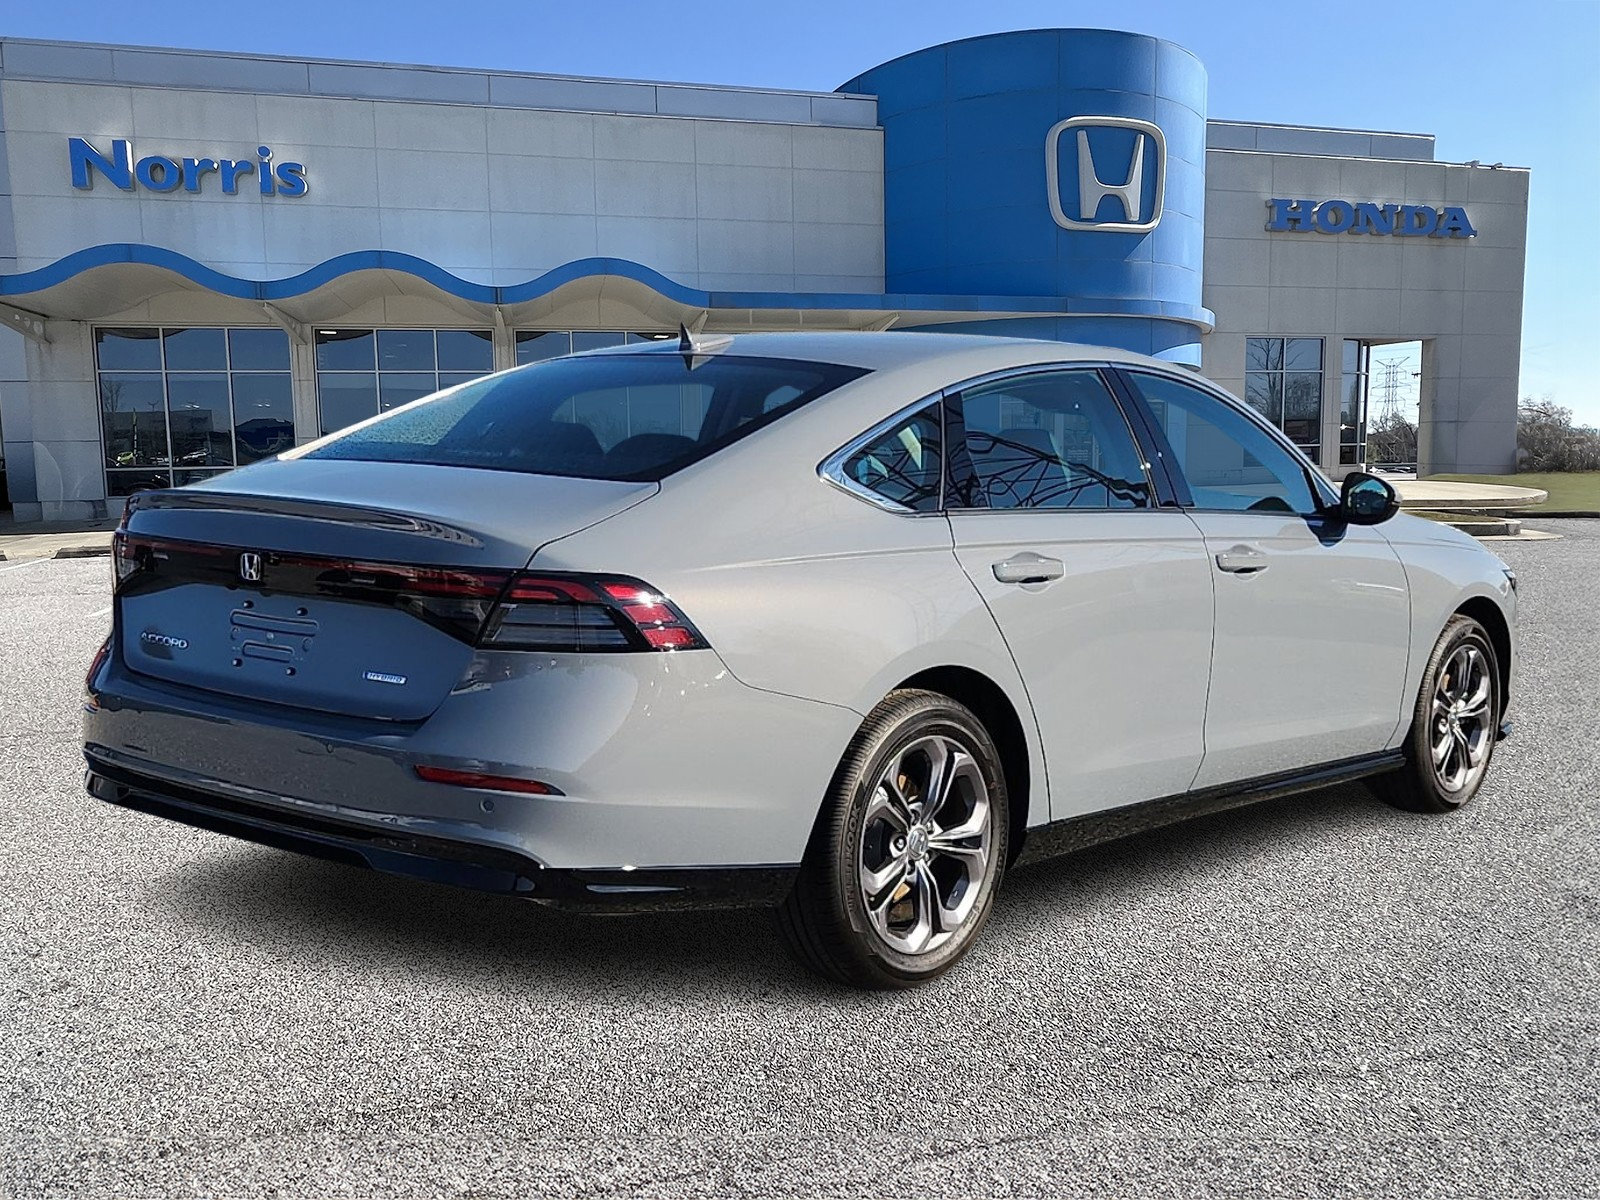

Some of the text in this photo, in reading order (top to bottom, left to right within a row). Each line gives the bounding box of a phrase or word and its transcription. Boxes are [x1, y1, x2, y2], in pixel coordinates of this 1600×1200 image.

[68, 137, 308, 197] Norris
[1265, 198, 1477, 239] HONDA
[141, 632, 188, 648] ACCORD
